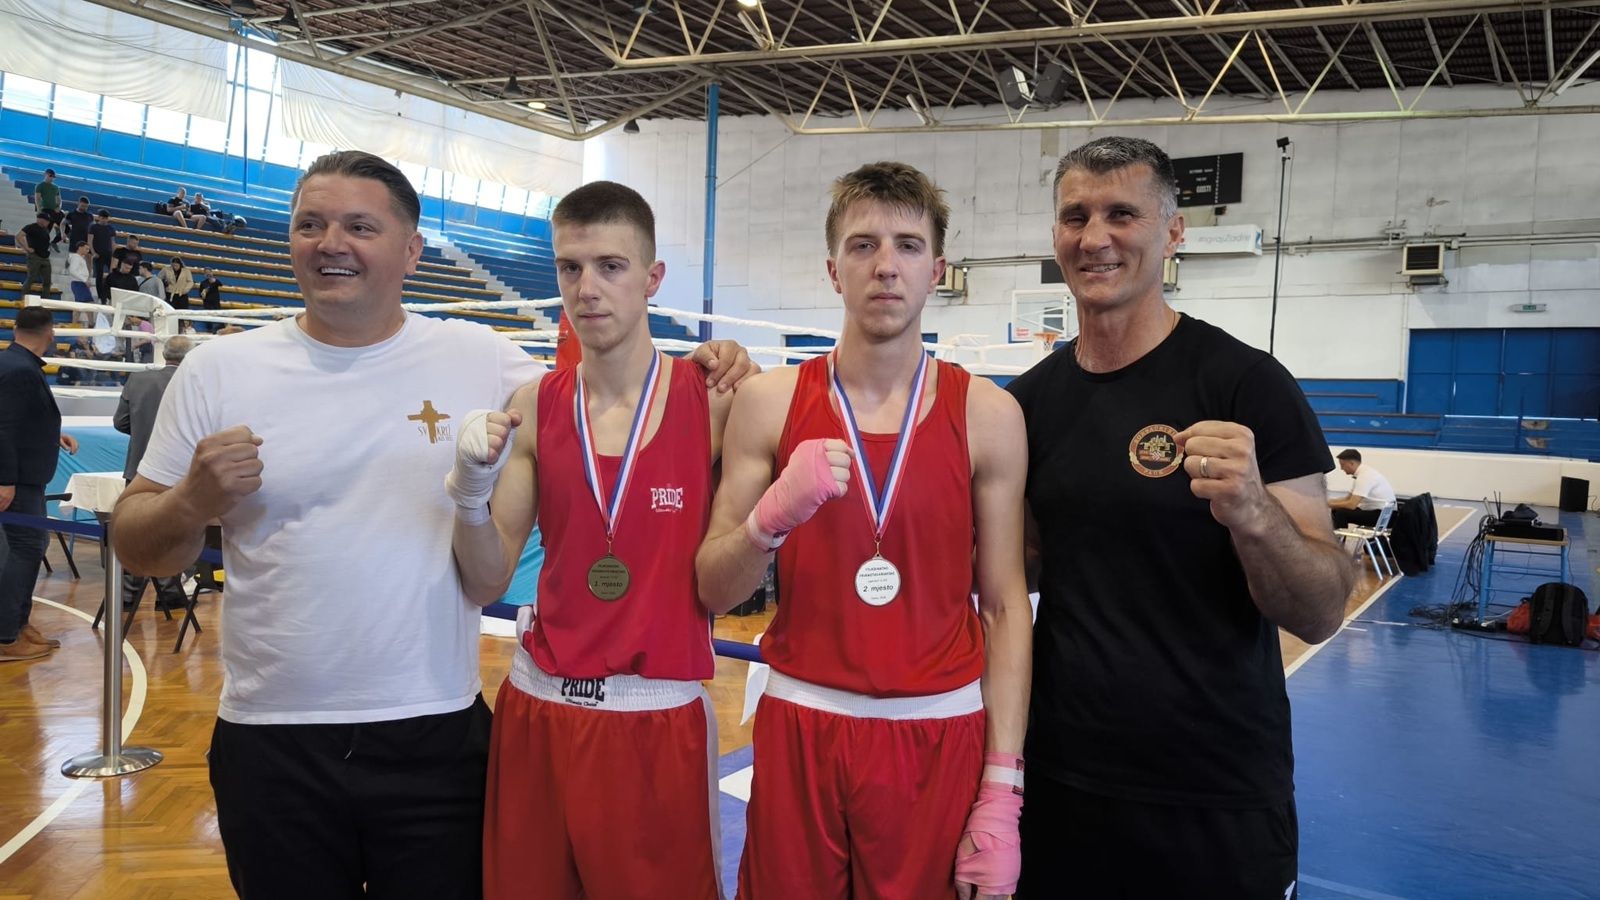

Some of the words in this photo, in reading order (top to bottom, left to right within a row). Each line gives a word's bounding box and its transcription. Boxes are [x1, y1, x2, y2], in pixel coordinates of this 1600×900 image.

[650, 487, 684, 509] PRIDE
[602, 581, 623, 589] mjesto
[863, 585, 869, 593] 2.
[871, 584, 894, 593] mjesto
[561, 677, 606, 702] PRIDE
